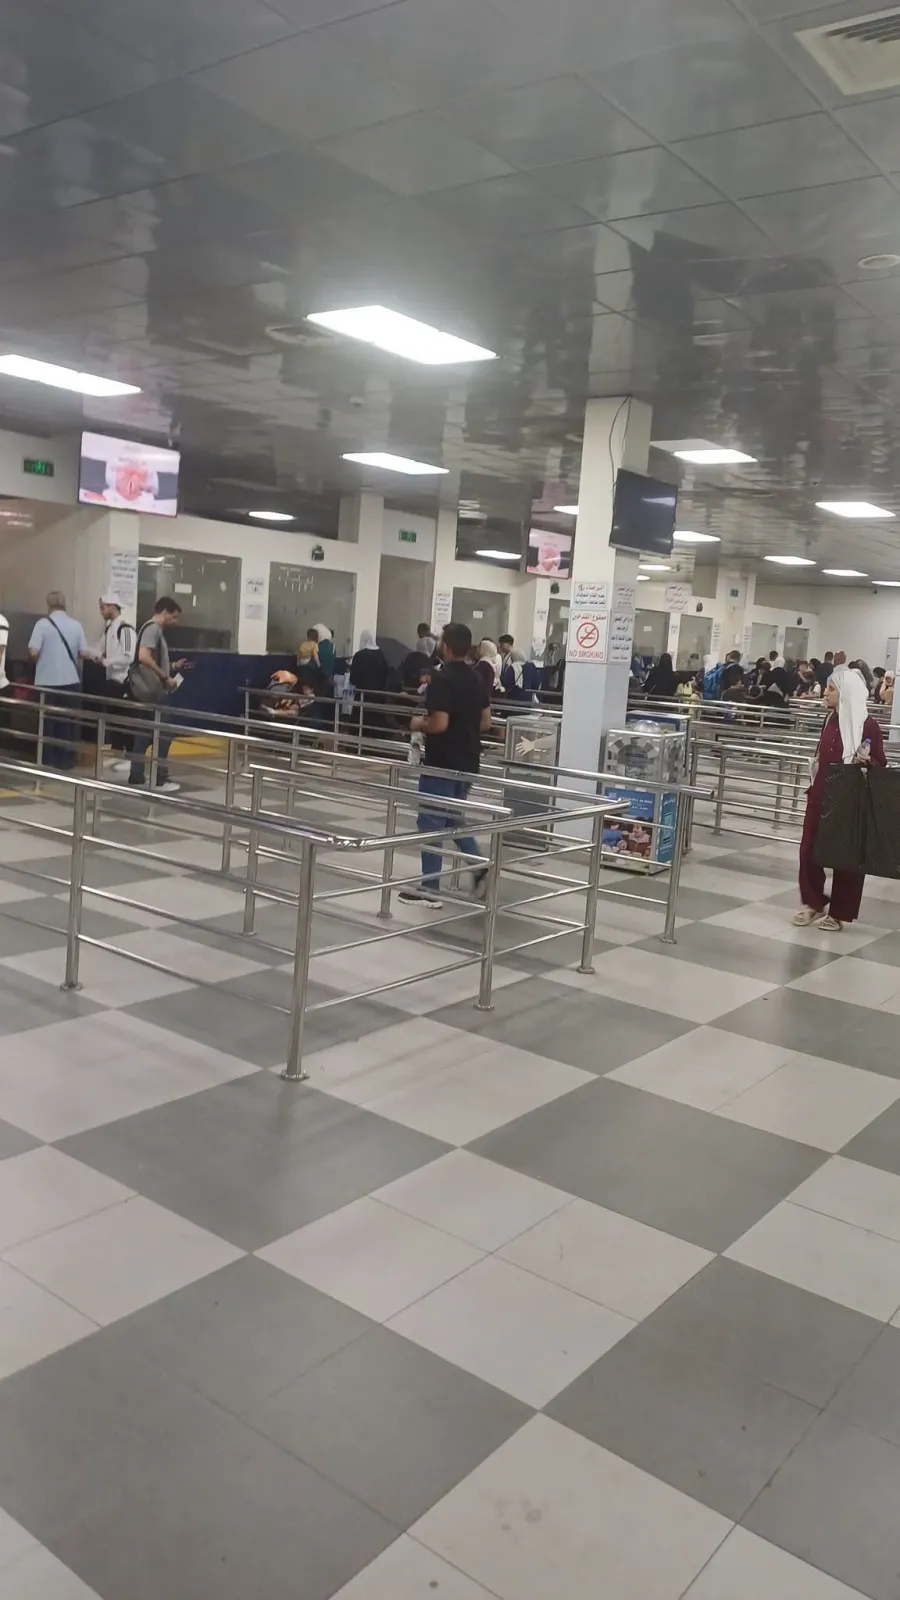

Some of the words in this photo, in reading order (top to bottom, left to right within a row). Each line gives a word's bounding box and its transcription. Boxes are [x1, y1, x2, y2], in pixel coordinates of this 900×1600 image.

[592, 613, 607, 622] ممنوع
[569, 649, 578, 657] NO
[577, 650, 604, 658] SMOKING
